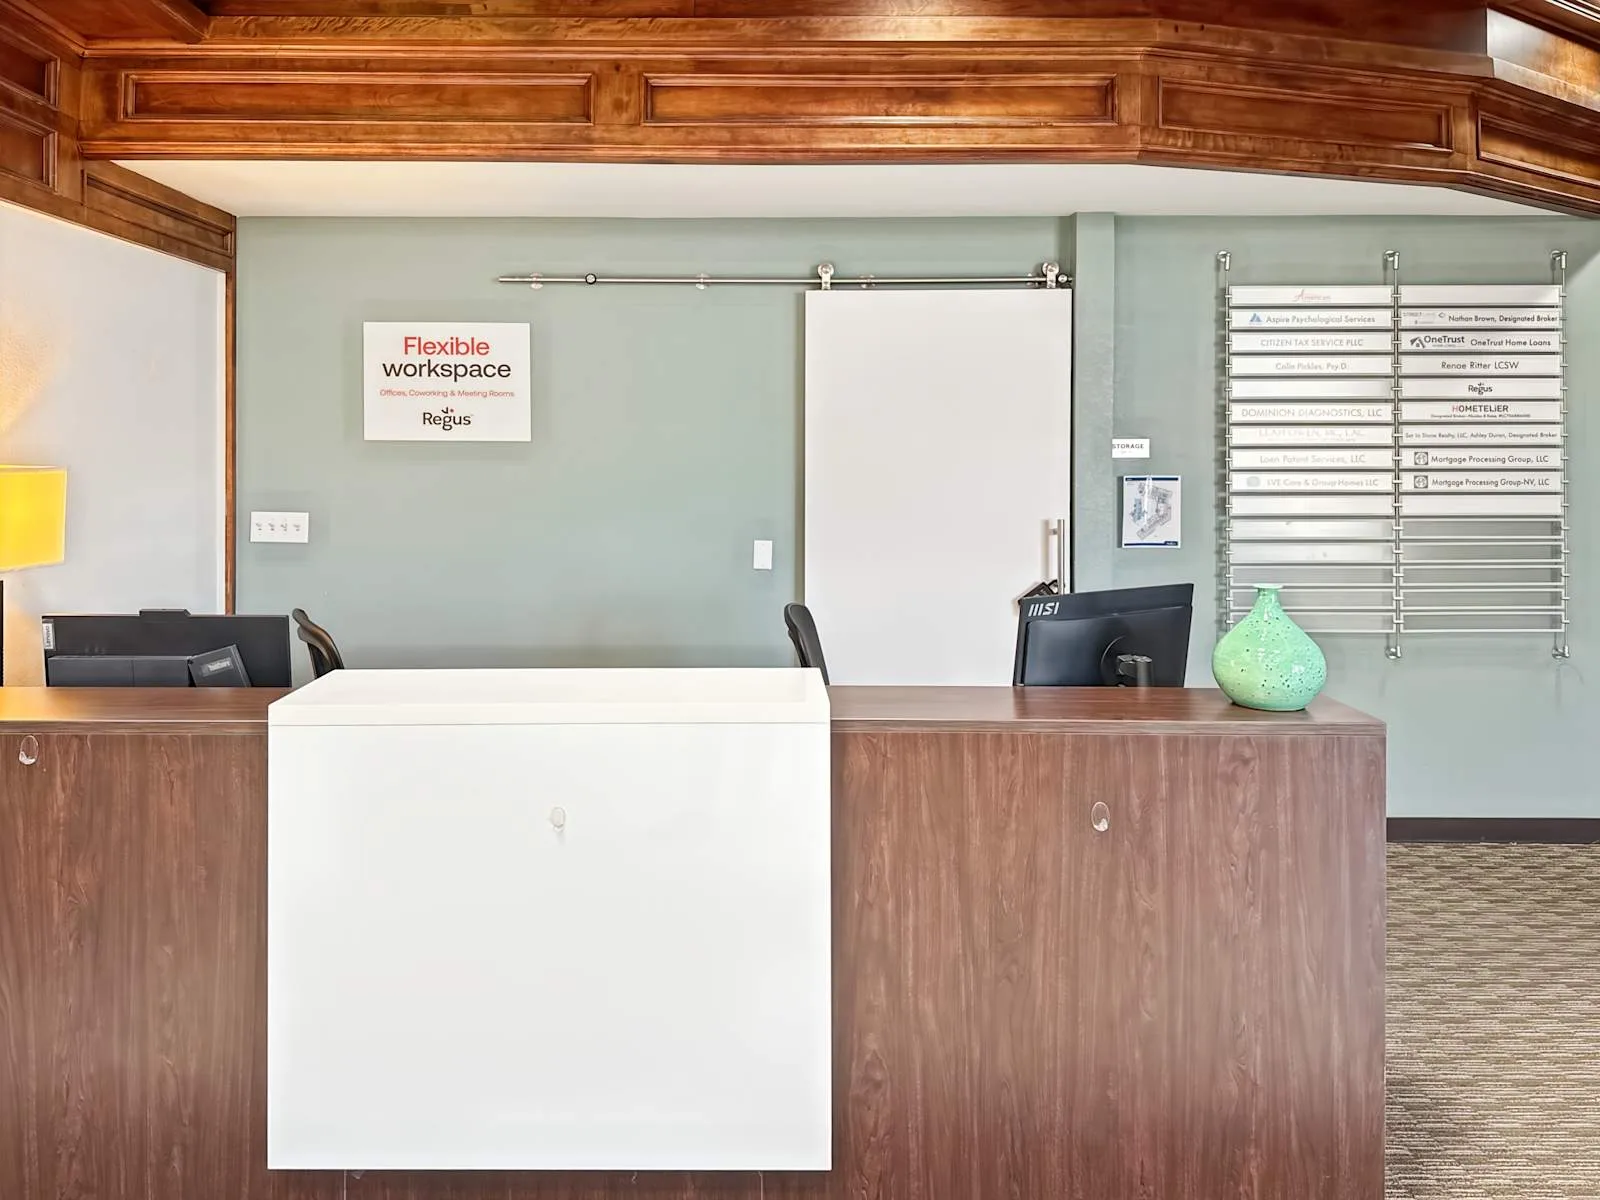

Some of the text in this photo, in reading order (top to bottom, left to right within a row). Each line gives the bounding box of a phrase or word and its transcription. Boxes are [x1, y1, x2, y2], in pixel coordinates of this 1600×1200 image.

[1266, 314, 1376, 324] Aspire Psychological Services
[1448, 315, 1557, 324] Nathan Brown, Designated Broker
[1260, 338, 1364, 347] CITIZEN TAX SERVICE PLLC
[1424, 335, 1465, 343] OneTrust
[404, 336, 490, 356] Flexible
[1469, 361, 1491, 370] Ritter
[1494, 361, 1520, 370] LCSW
[382, 359, 512, 383] workspace
[379, 389, 408, 398] Offices,
[408, 389, 448, 399] Coworking
[457, 389, 487, 399] Meeting
[489, 390, 515, 398] Rooms
[1468, 384, 1493, 395] Regus
[1241, 408, 1383, 418] DOMINION DIAGNOSTICS, LLC
[422, 409, 472, 431] Regus
[1508, 432, 1538, 440] Designated
[1350, 455, 1367, 463] LLC
[1431, 455, 1467, 464] Mortgage
[1468, 455, 1506, 464] Processing
[1508, 455, 1533, 464] Group,
[1303, 479, 1310, 487] &
[1365, 478, 1379, 487] LLC
[1432, 478, 1550, 488] Mortgage Processing Group-NV, LLC
[1028, 601, 1060, 617] MSI
